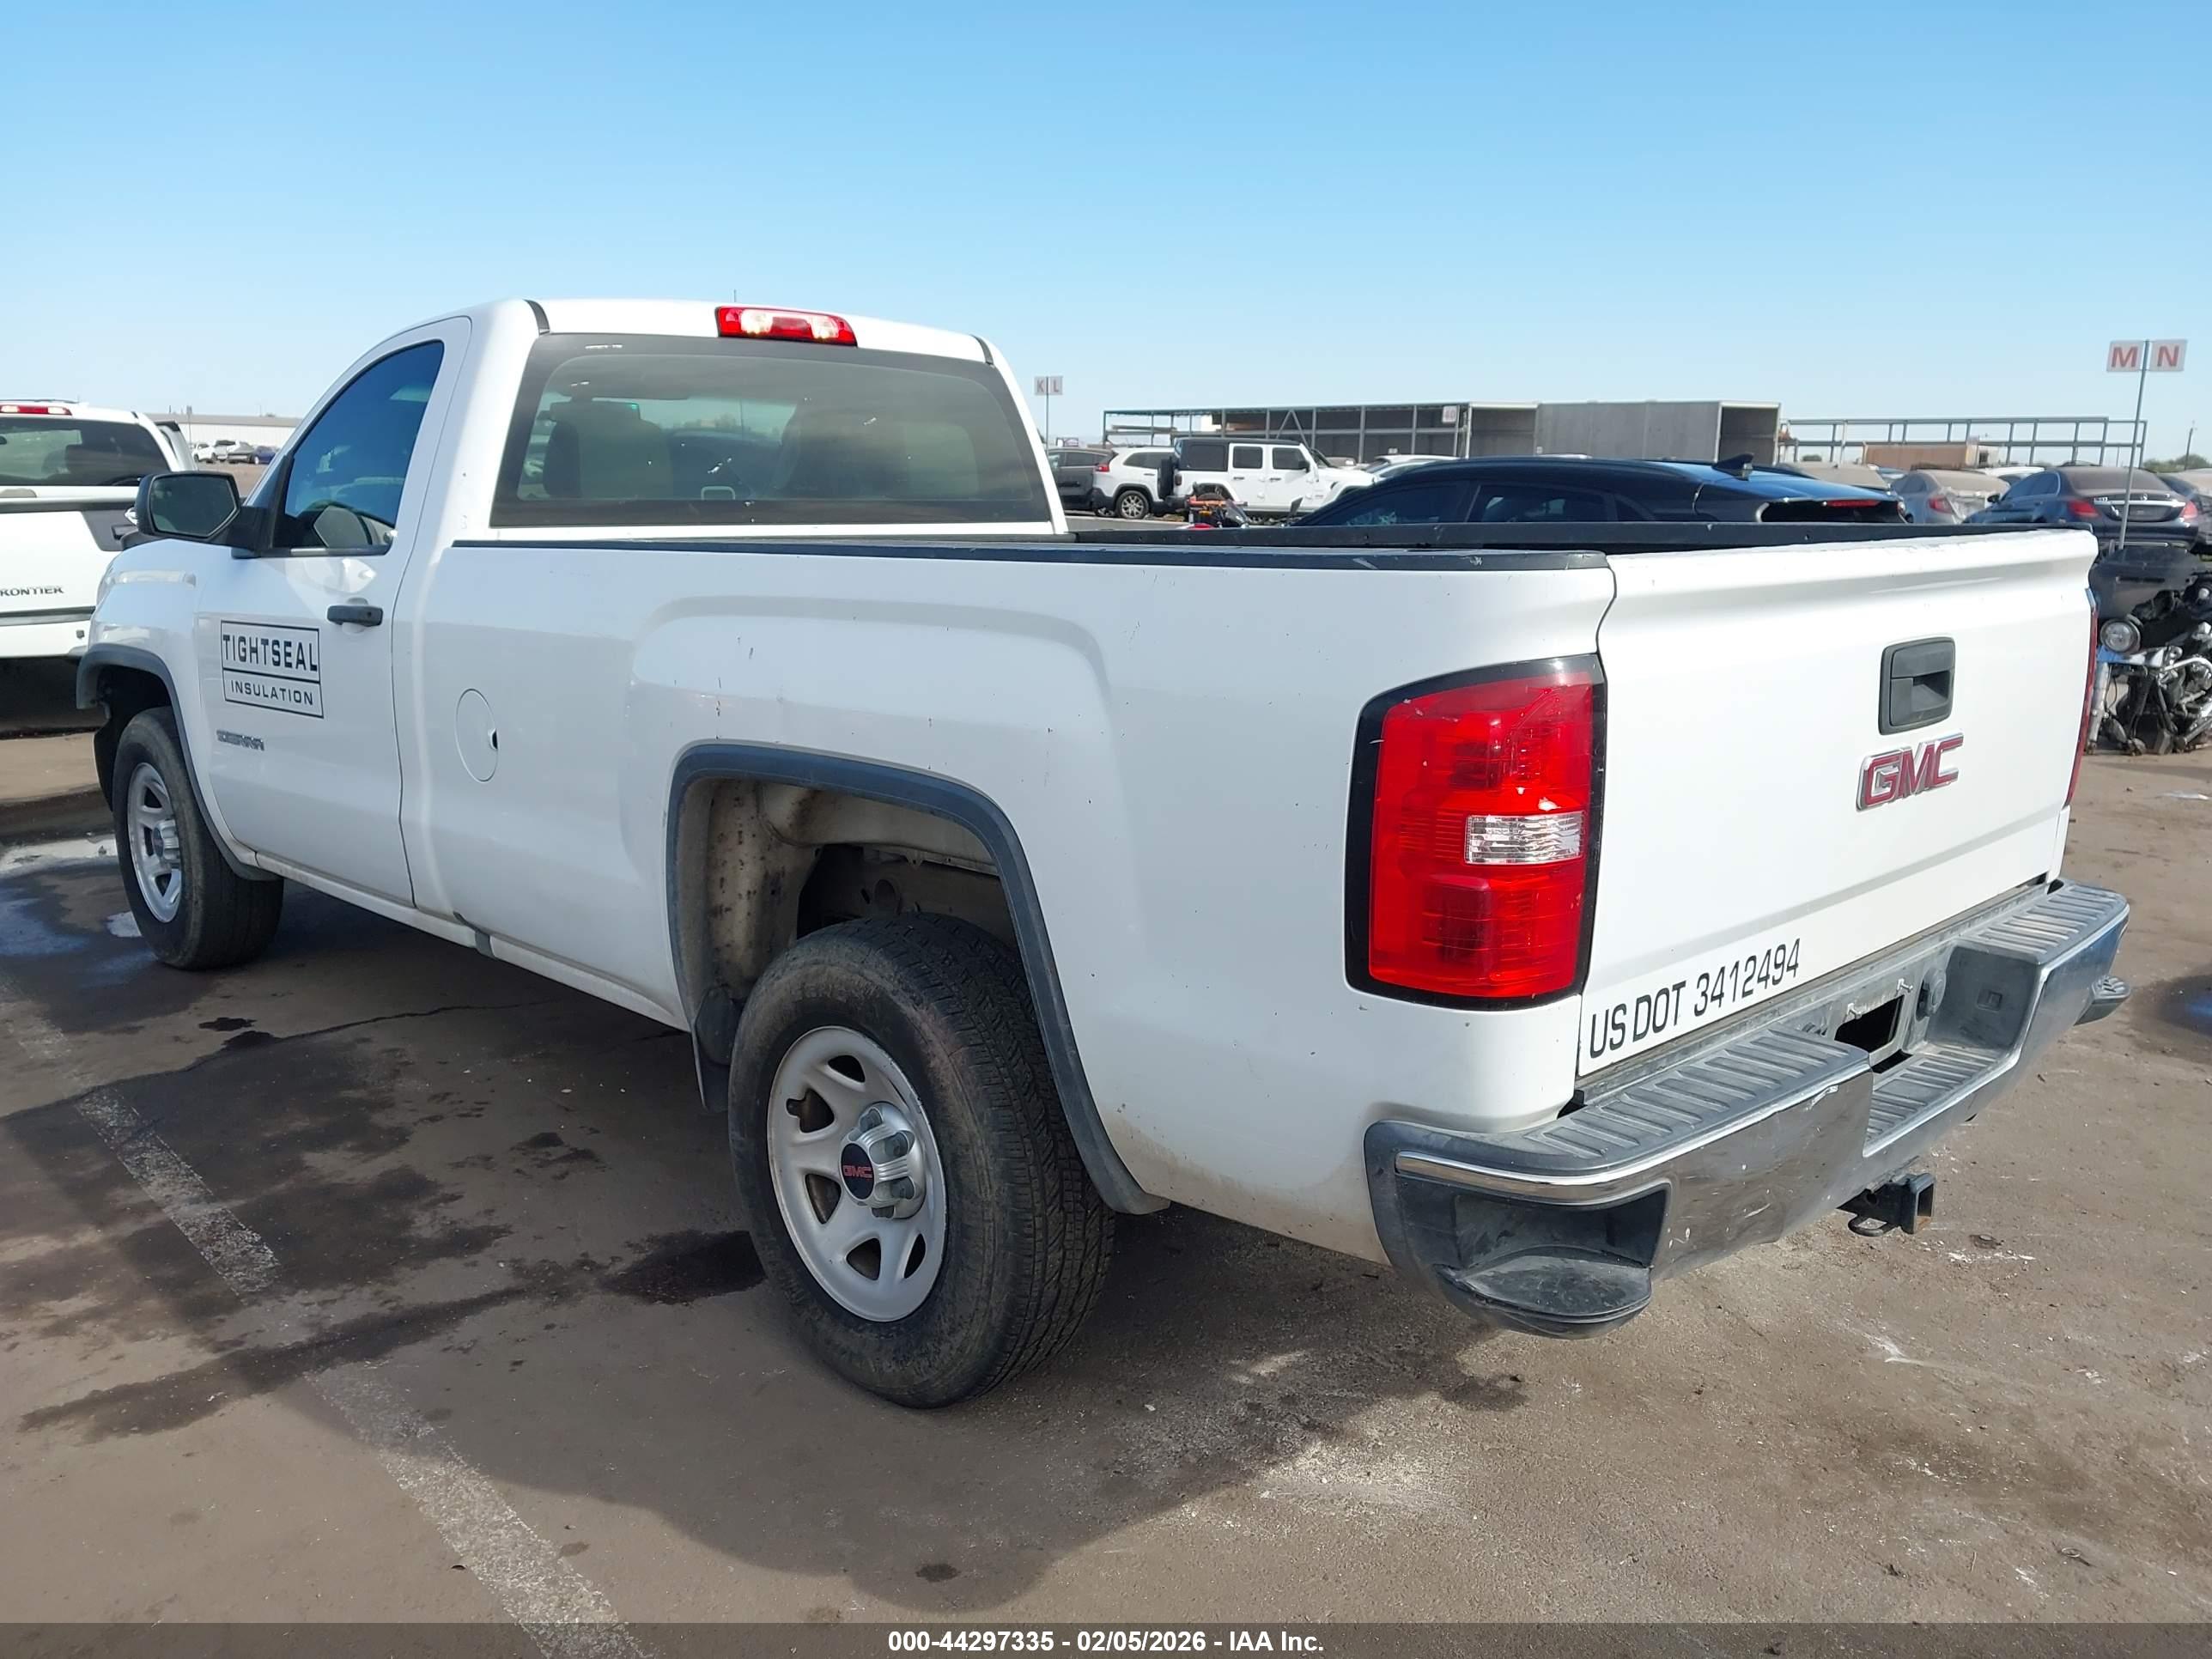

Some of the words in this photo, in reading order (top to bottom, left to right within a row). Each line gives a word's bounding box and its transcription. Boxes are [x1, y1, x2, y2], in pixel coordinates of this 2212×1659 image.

[2111, 346, 2138, 368] M
[2156, 345, 2179, 367] N
[1036, 380, 1045, 392] K
[1053, 380, 1060, 392] L
[0, 586, 64, 597] RONTIER
[222, 634, 318, 672] TIGHTSEAL
[231, 679, 313, 706] INSULATION
[1856, 732, 1964, 812] GMC
[1693, 938, 1801, 1017] 3412494
[842, 1164, 872, 1178] GMC
